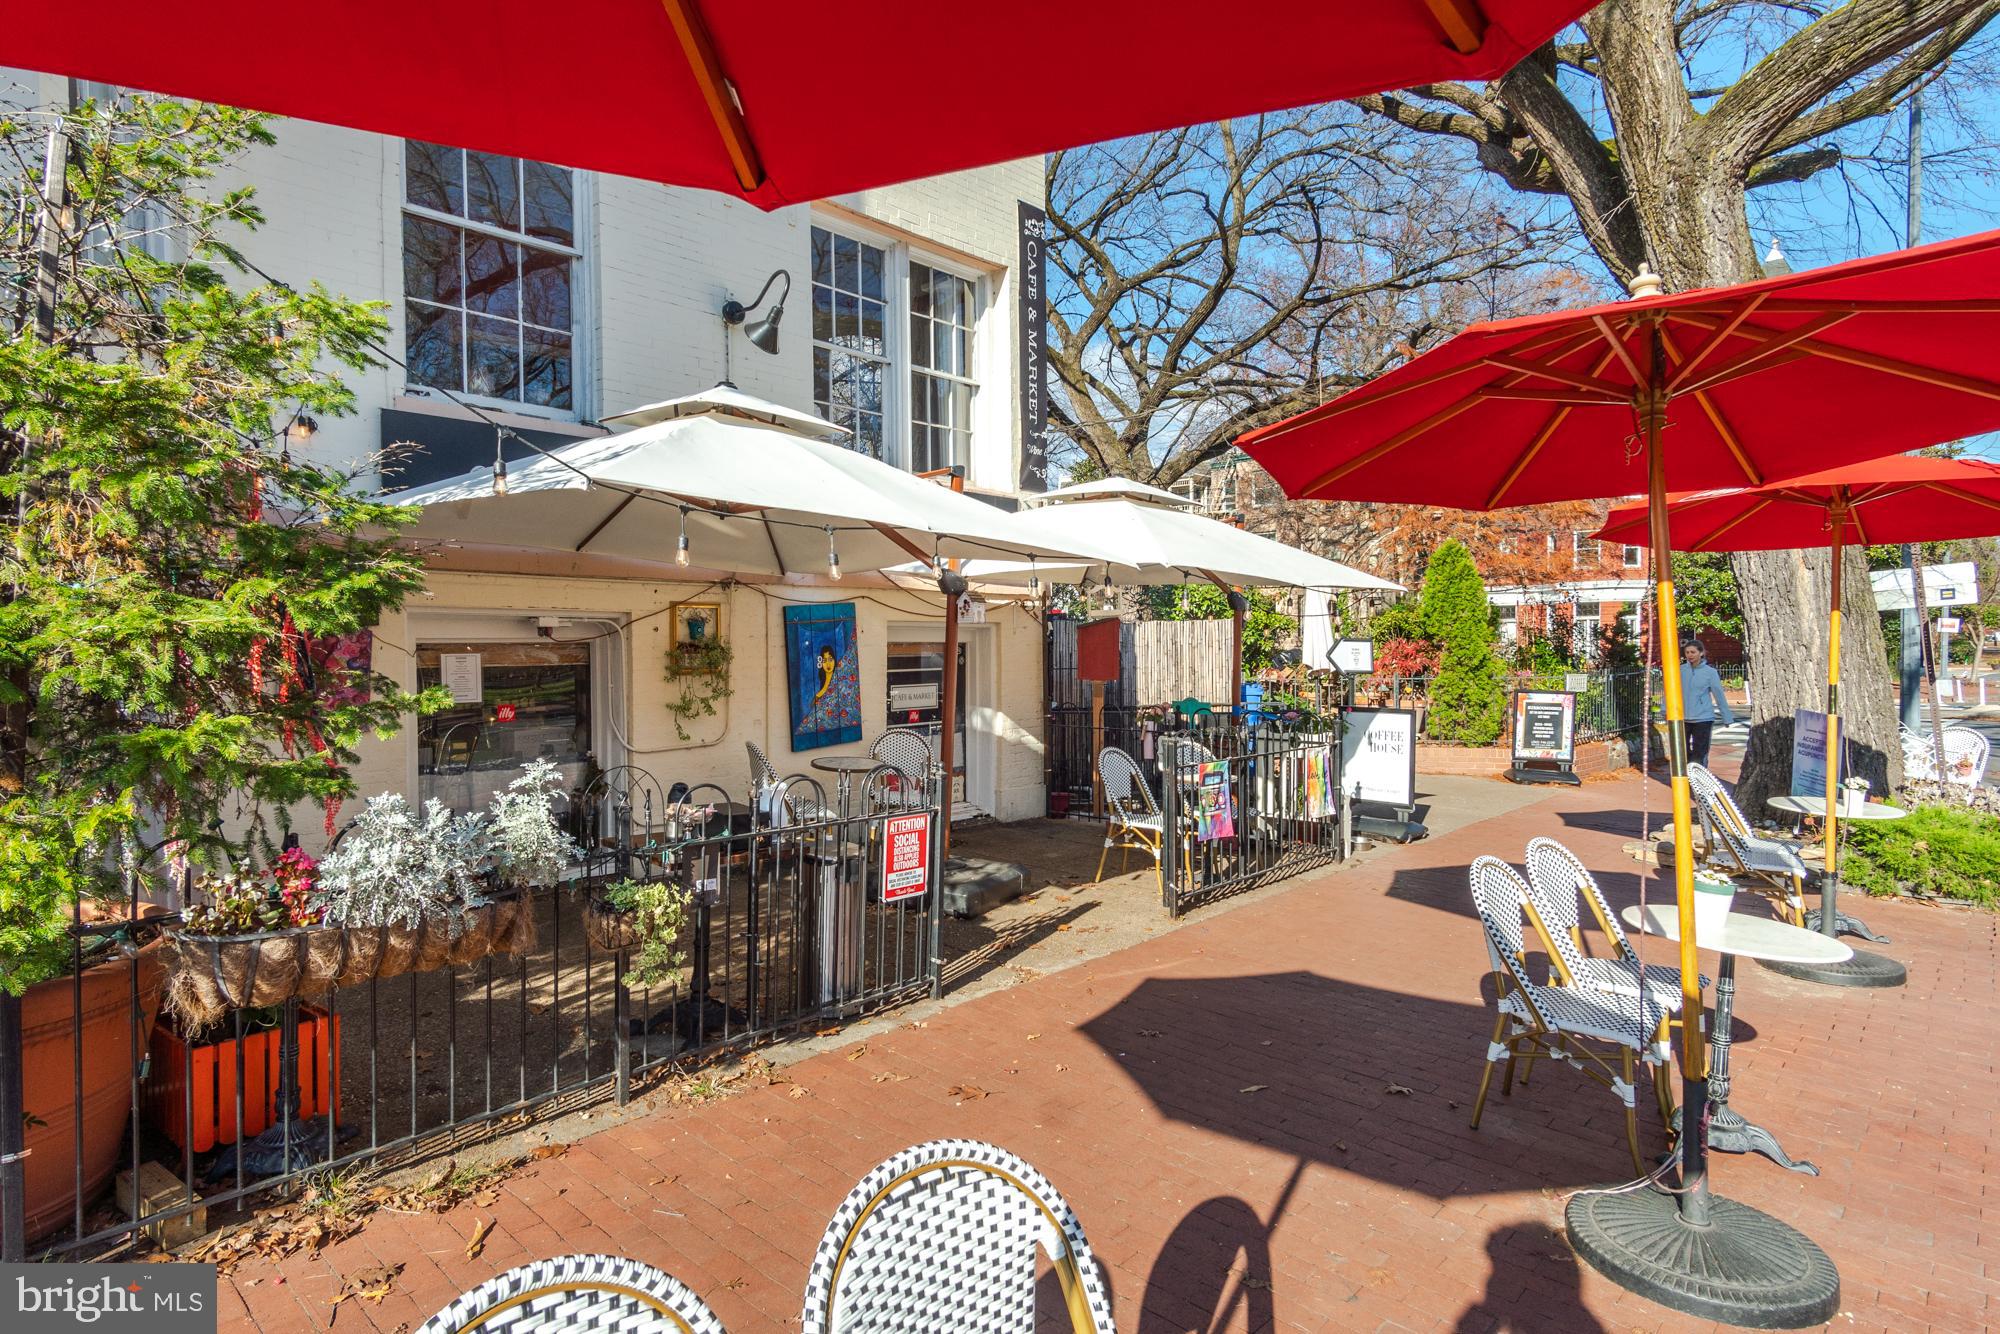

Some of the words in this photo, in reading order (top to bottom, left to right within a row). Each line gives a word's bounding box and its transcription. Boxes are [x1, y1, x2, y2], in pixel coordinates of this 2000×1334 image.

[1027, 241, 1037, 300] CAFE
[1028, 307, 1037, 323] &
[1028, 329, 1038, 425] MARKET
[1027, 443, 1042, 456] Wine
[499, 707, 514, 721] illy
[1370, 742, 1404, 755] HOUSE
[890, 817, 925, 833] ATTENTION
[894, 832, 919, 847] SOCIAL
[894, 845, 919, 855] DISTANCING
[904, 852, 919, 860] APPLIES
[893, 859, 919, 871] OUTDOORS
